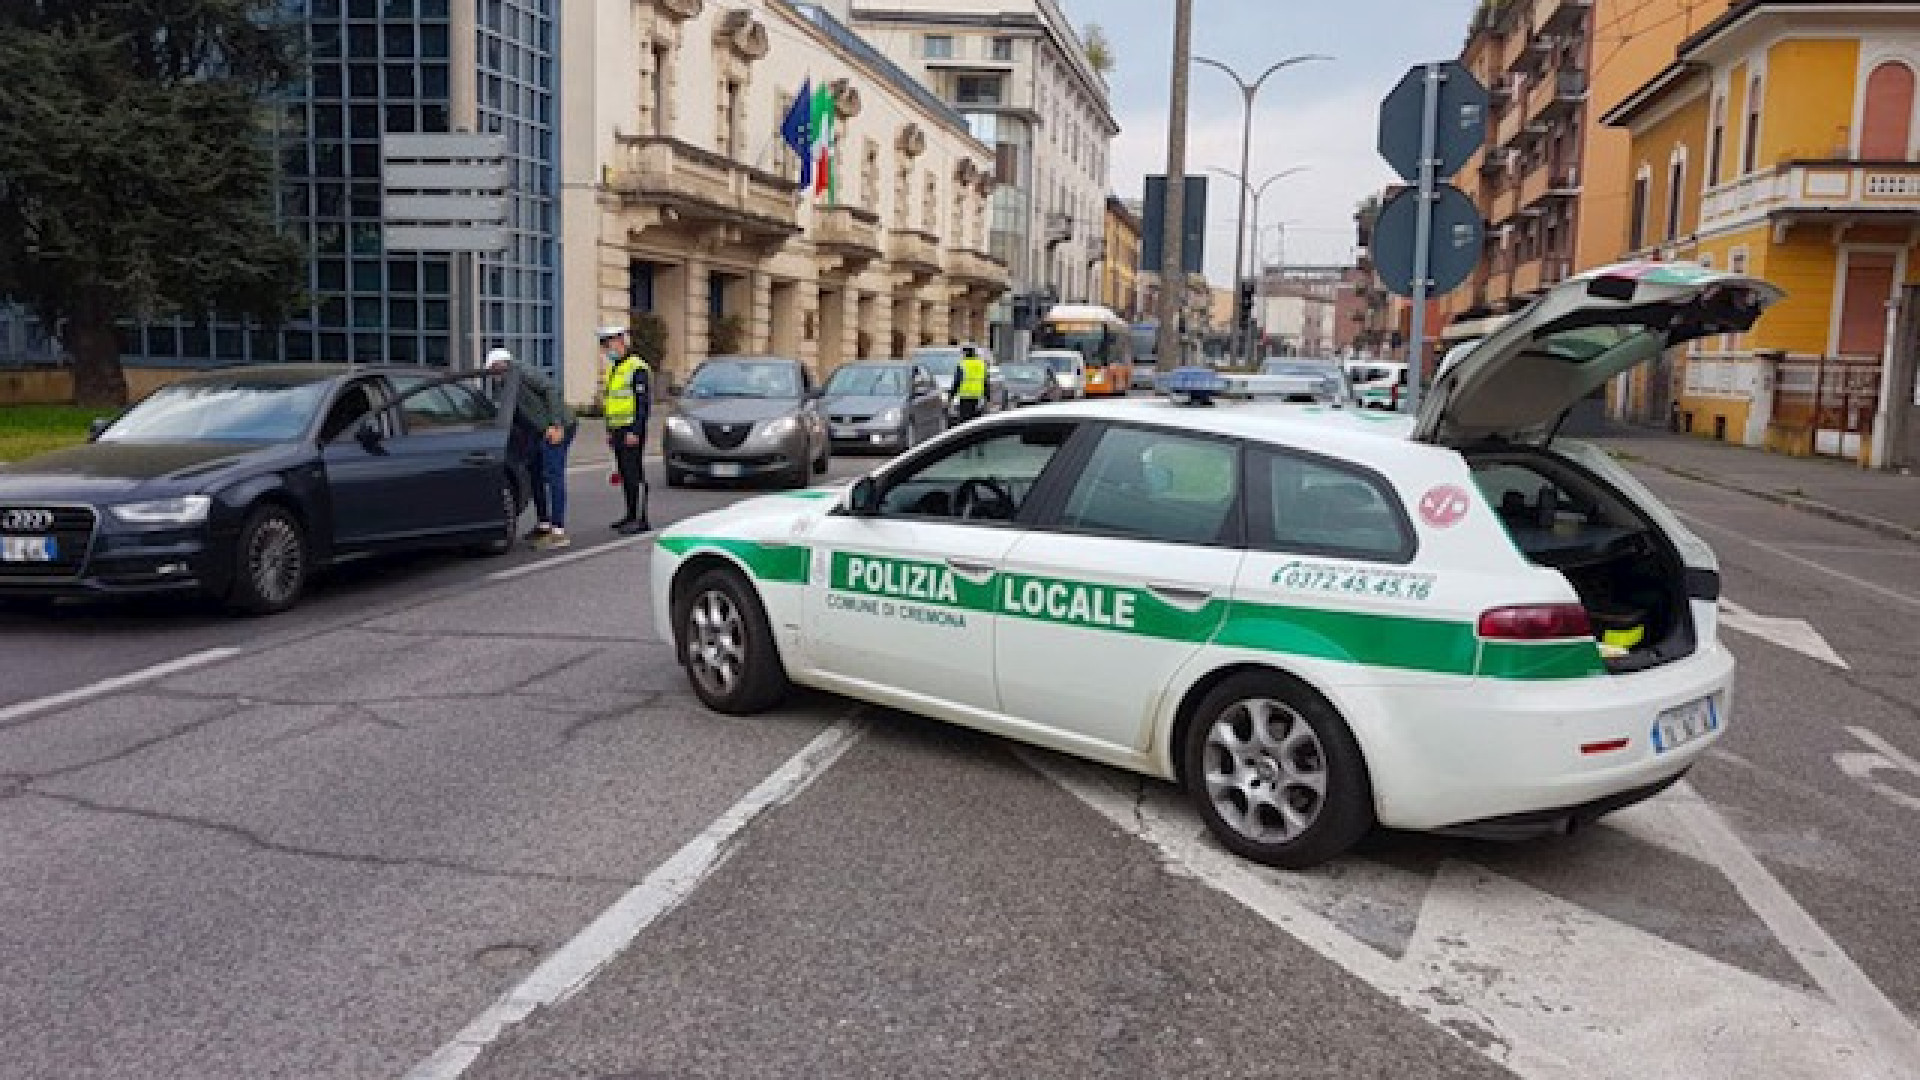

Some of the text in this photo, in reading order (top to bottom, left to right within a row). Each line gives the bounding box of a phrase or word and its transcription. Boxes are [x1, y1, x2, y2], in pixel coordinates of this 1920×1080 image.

[848, 557, 1136, 628] POLIZIA LOCALE
[1285, 570, 1431, 600] 0372.45.45.16
[825, 593, 966, 627] COMUNE DI CREMONA
